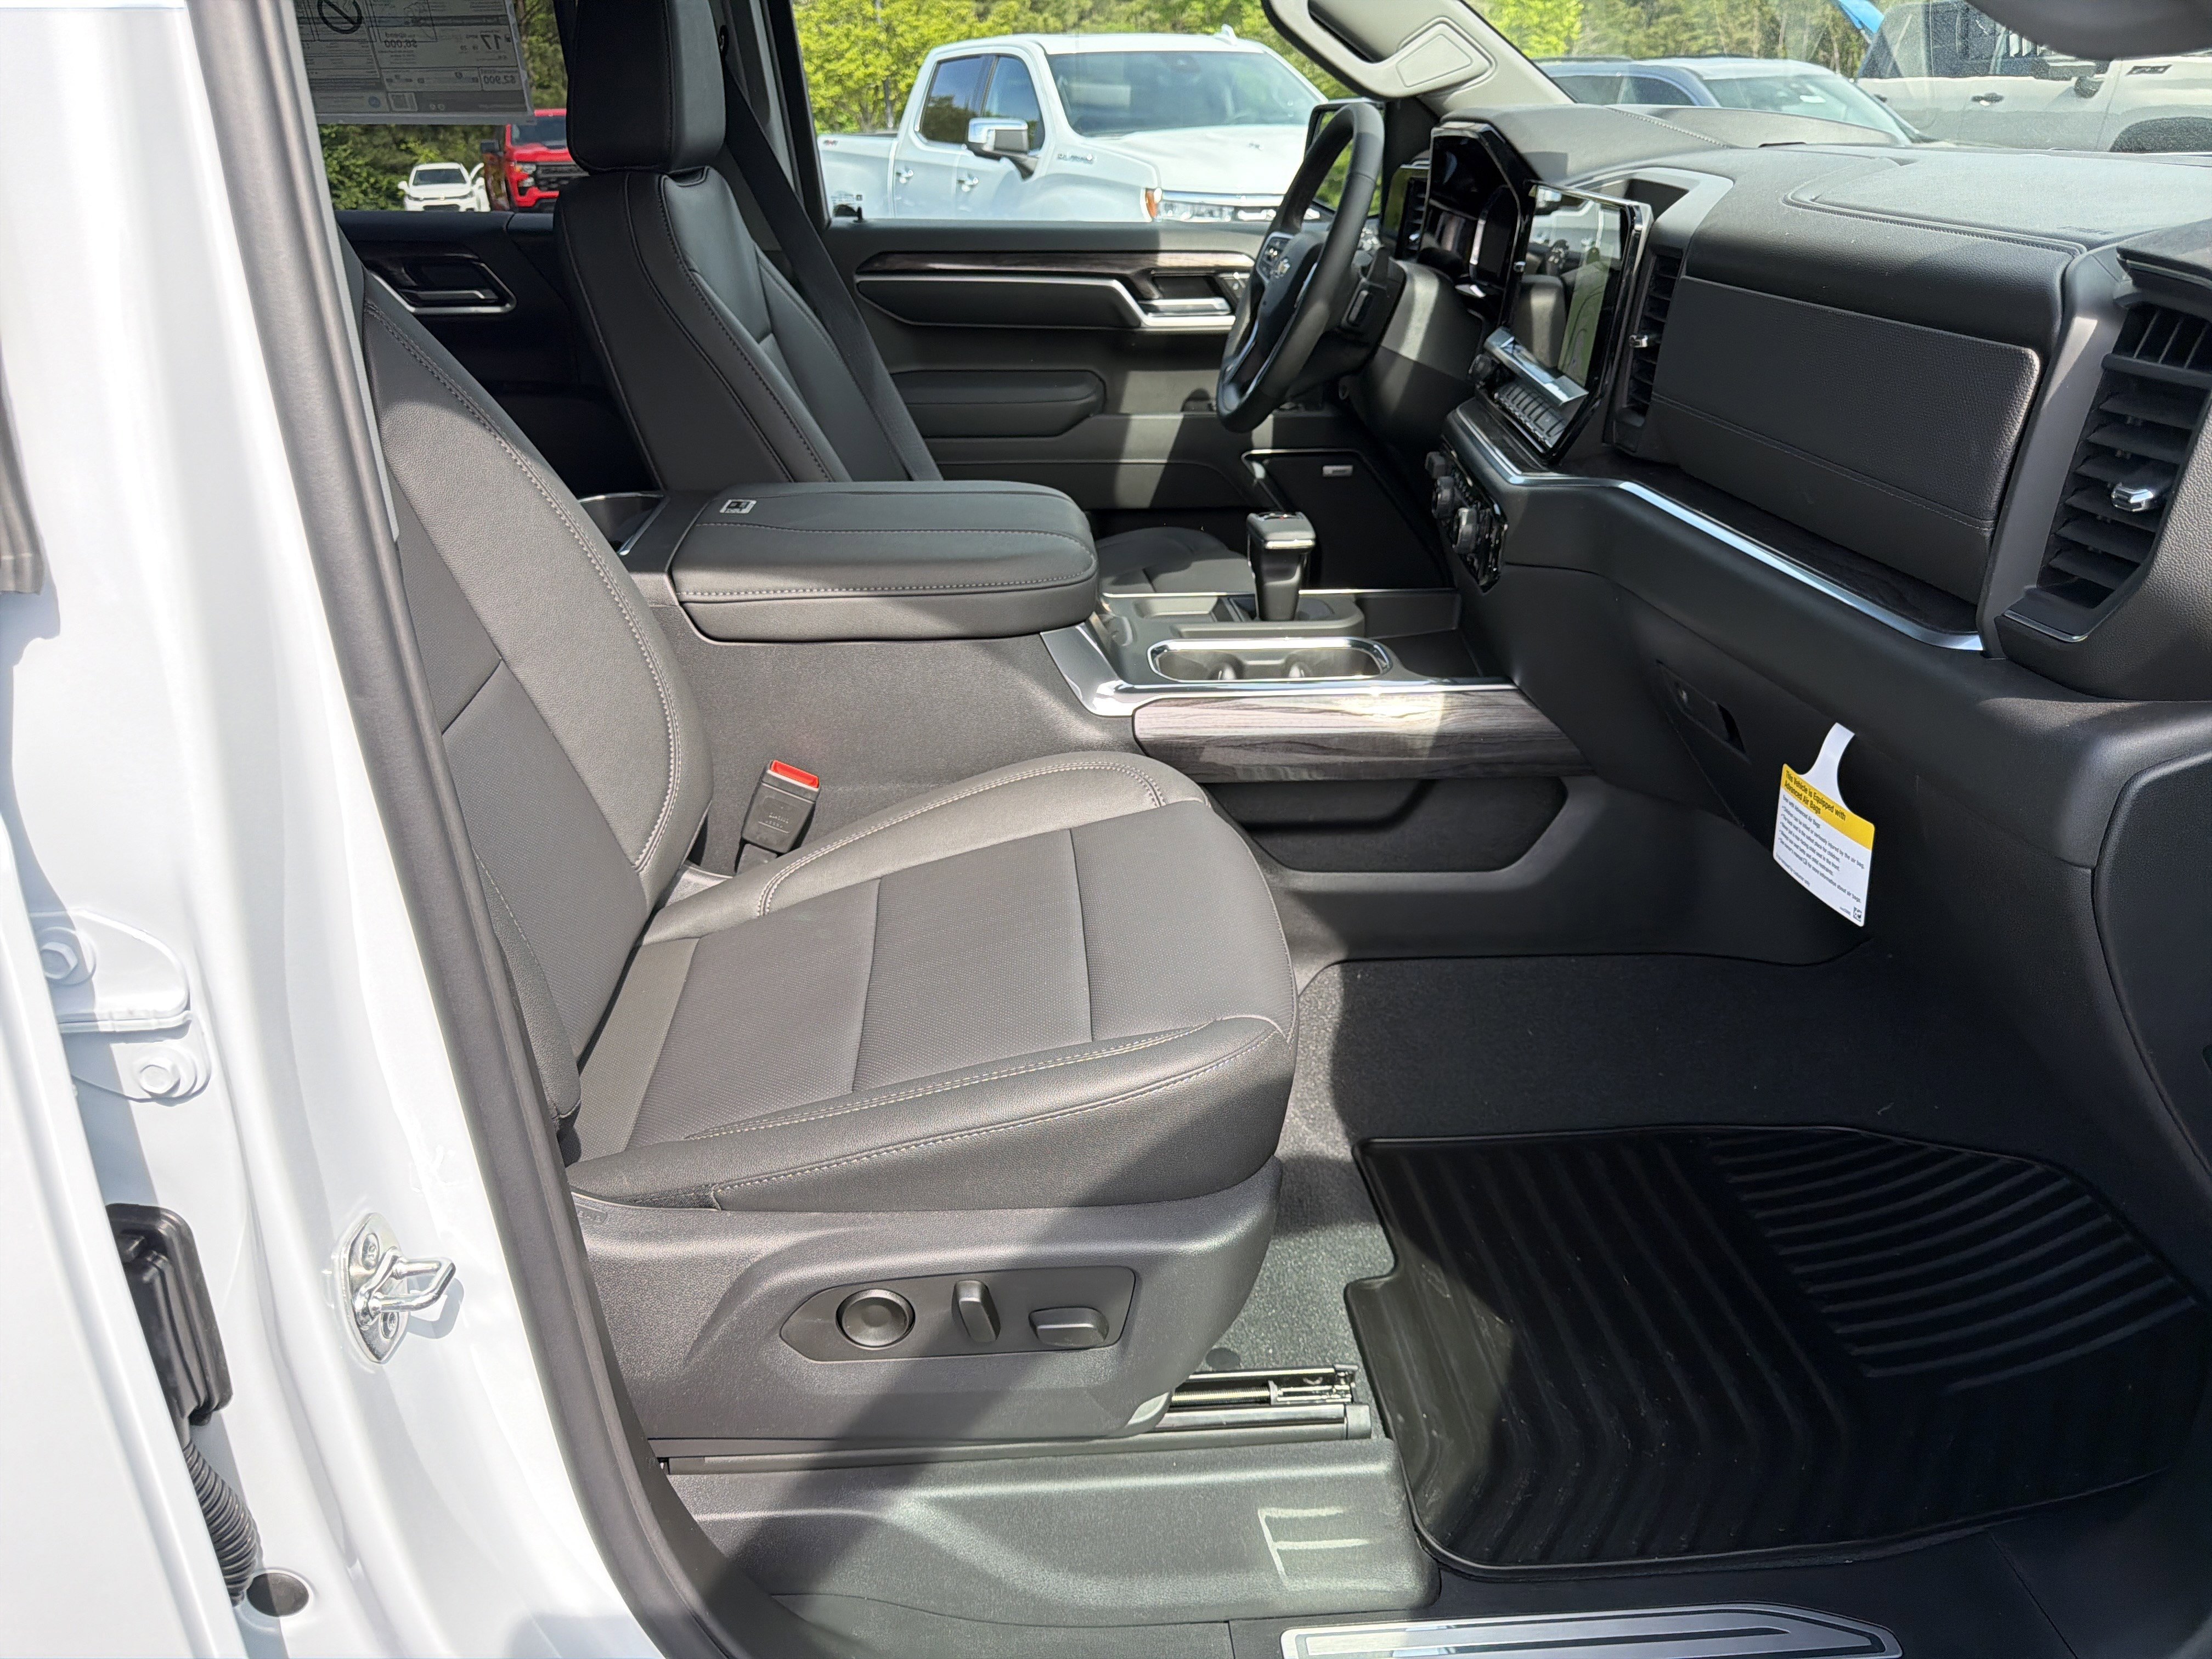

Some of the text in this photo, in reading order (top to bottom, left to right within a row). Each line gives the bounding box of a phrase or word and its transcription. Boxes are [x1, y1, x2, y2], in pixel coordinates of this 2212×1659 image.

[1784, 780, 1802, 800] Advanced
[1809, 799, 1821, 816] Bags
[1793, 777, 1808, 794] Vehicle
[1808, 788, 1813, 797] is
[1813, 792, 1834, 814] Equipped
[1835, 807, 1846, 821] with
[1837, 883, 1846, 894] about
